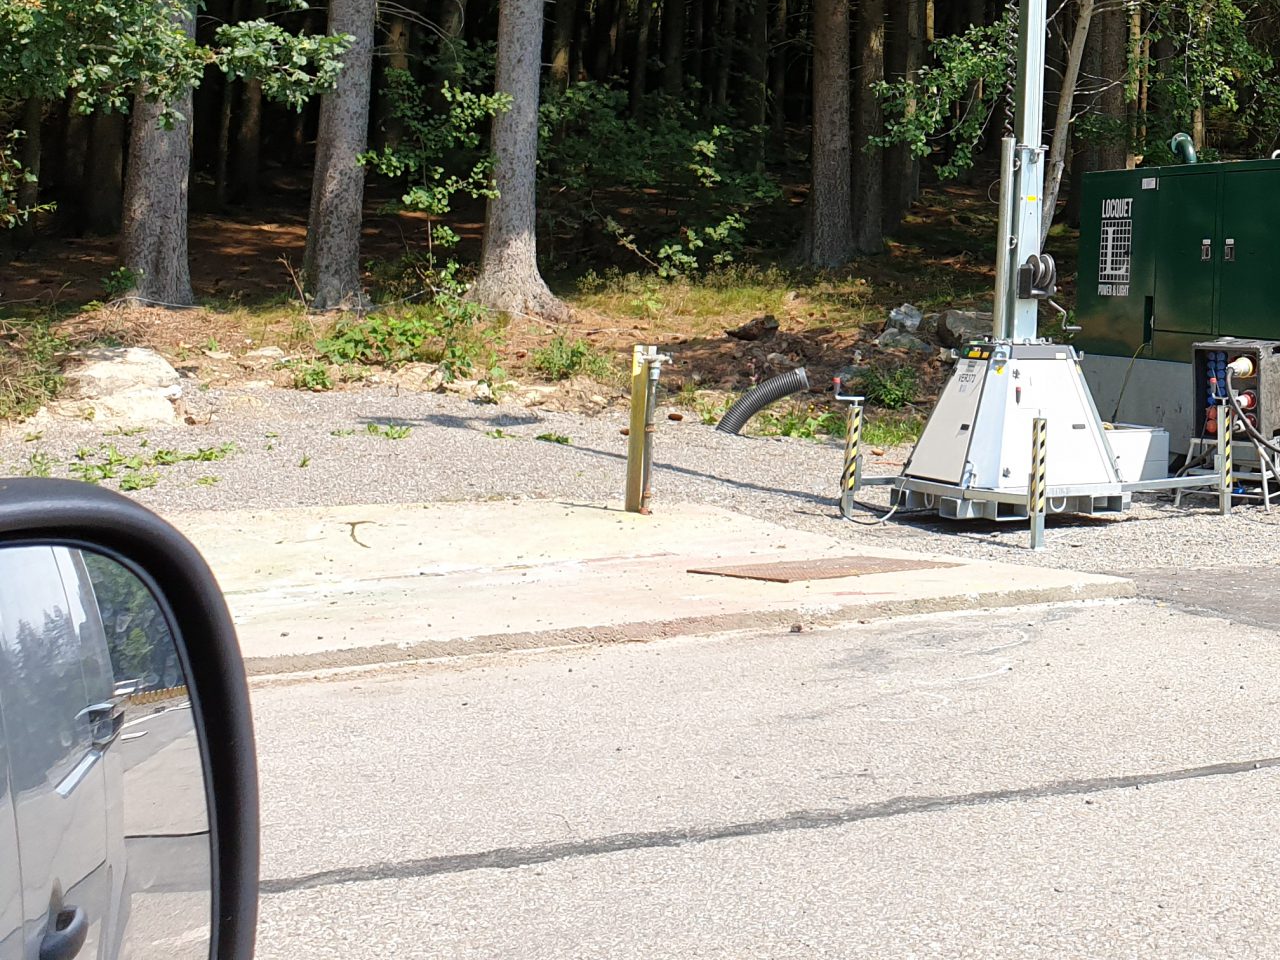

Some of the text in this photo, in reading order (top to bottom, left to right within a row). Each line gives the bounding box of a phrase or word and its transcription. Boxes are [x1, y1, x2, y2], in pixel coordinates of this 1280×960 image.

[1102, 198, 1133, 218] LOCQUET
[1098, 284, 1111, 296] POWER
[1117, 284, 1129, 296] LIGHT
